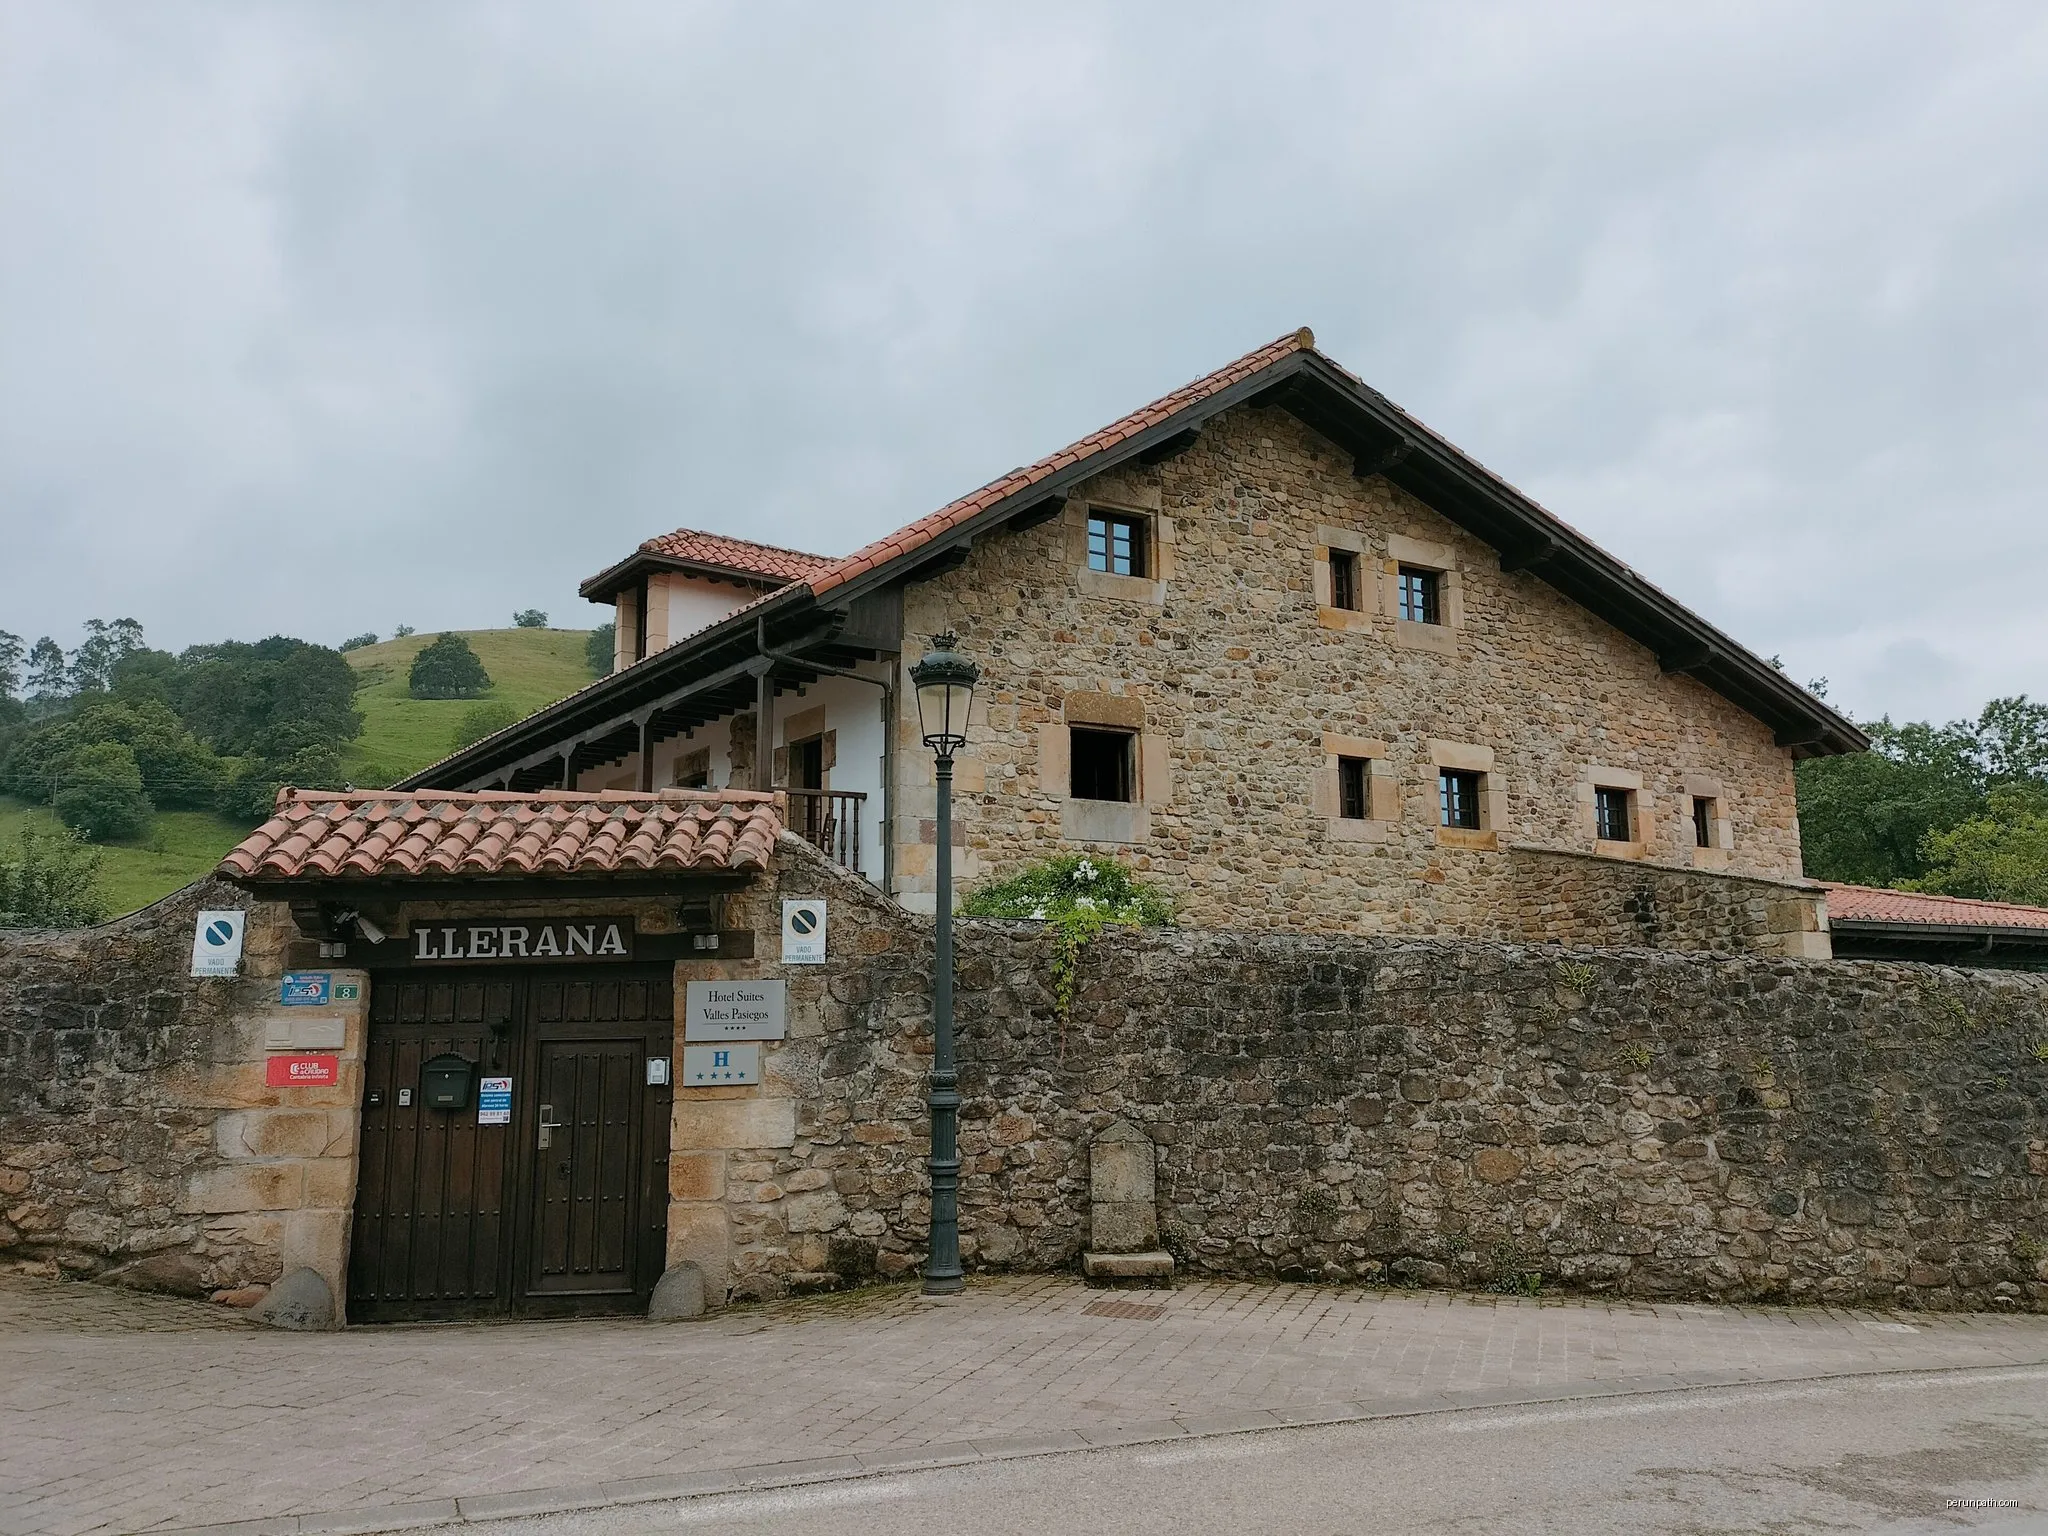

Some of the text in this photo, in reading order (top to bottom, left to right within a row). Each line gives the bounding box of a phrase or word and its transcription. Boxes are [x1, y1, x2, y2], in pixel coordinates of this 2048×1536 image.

[414, 924, 627, 959] LLERANA
[795, 945, 812, 953] VADO
[207, 958, 225, 966] VADO
[784, 954, 823, 962] PERMANENTE
[341, 987, 351, 999] 8
[707, 990, 764, 1002] Hotel Suites
[703, 1007, 769, 1022] Valles Pasiegos
[712, 1050, 730, 1068] H
[299, 1062, 319, 1070] CLUB
